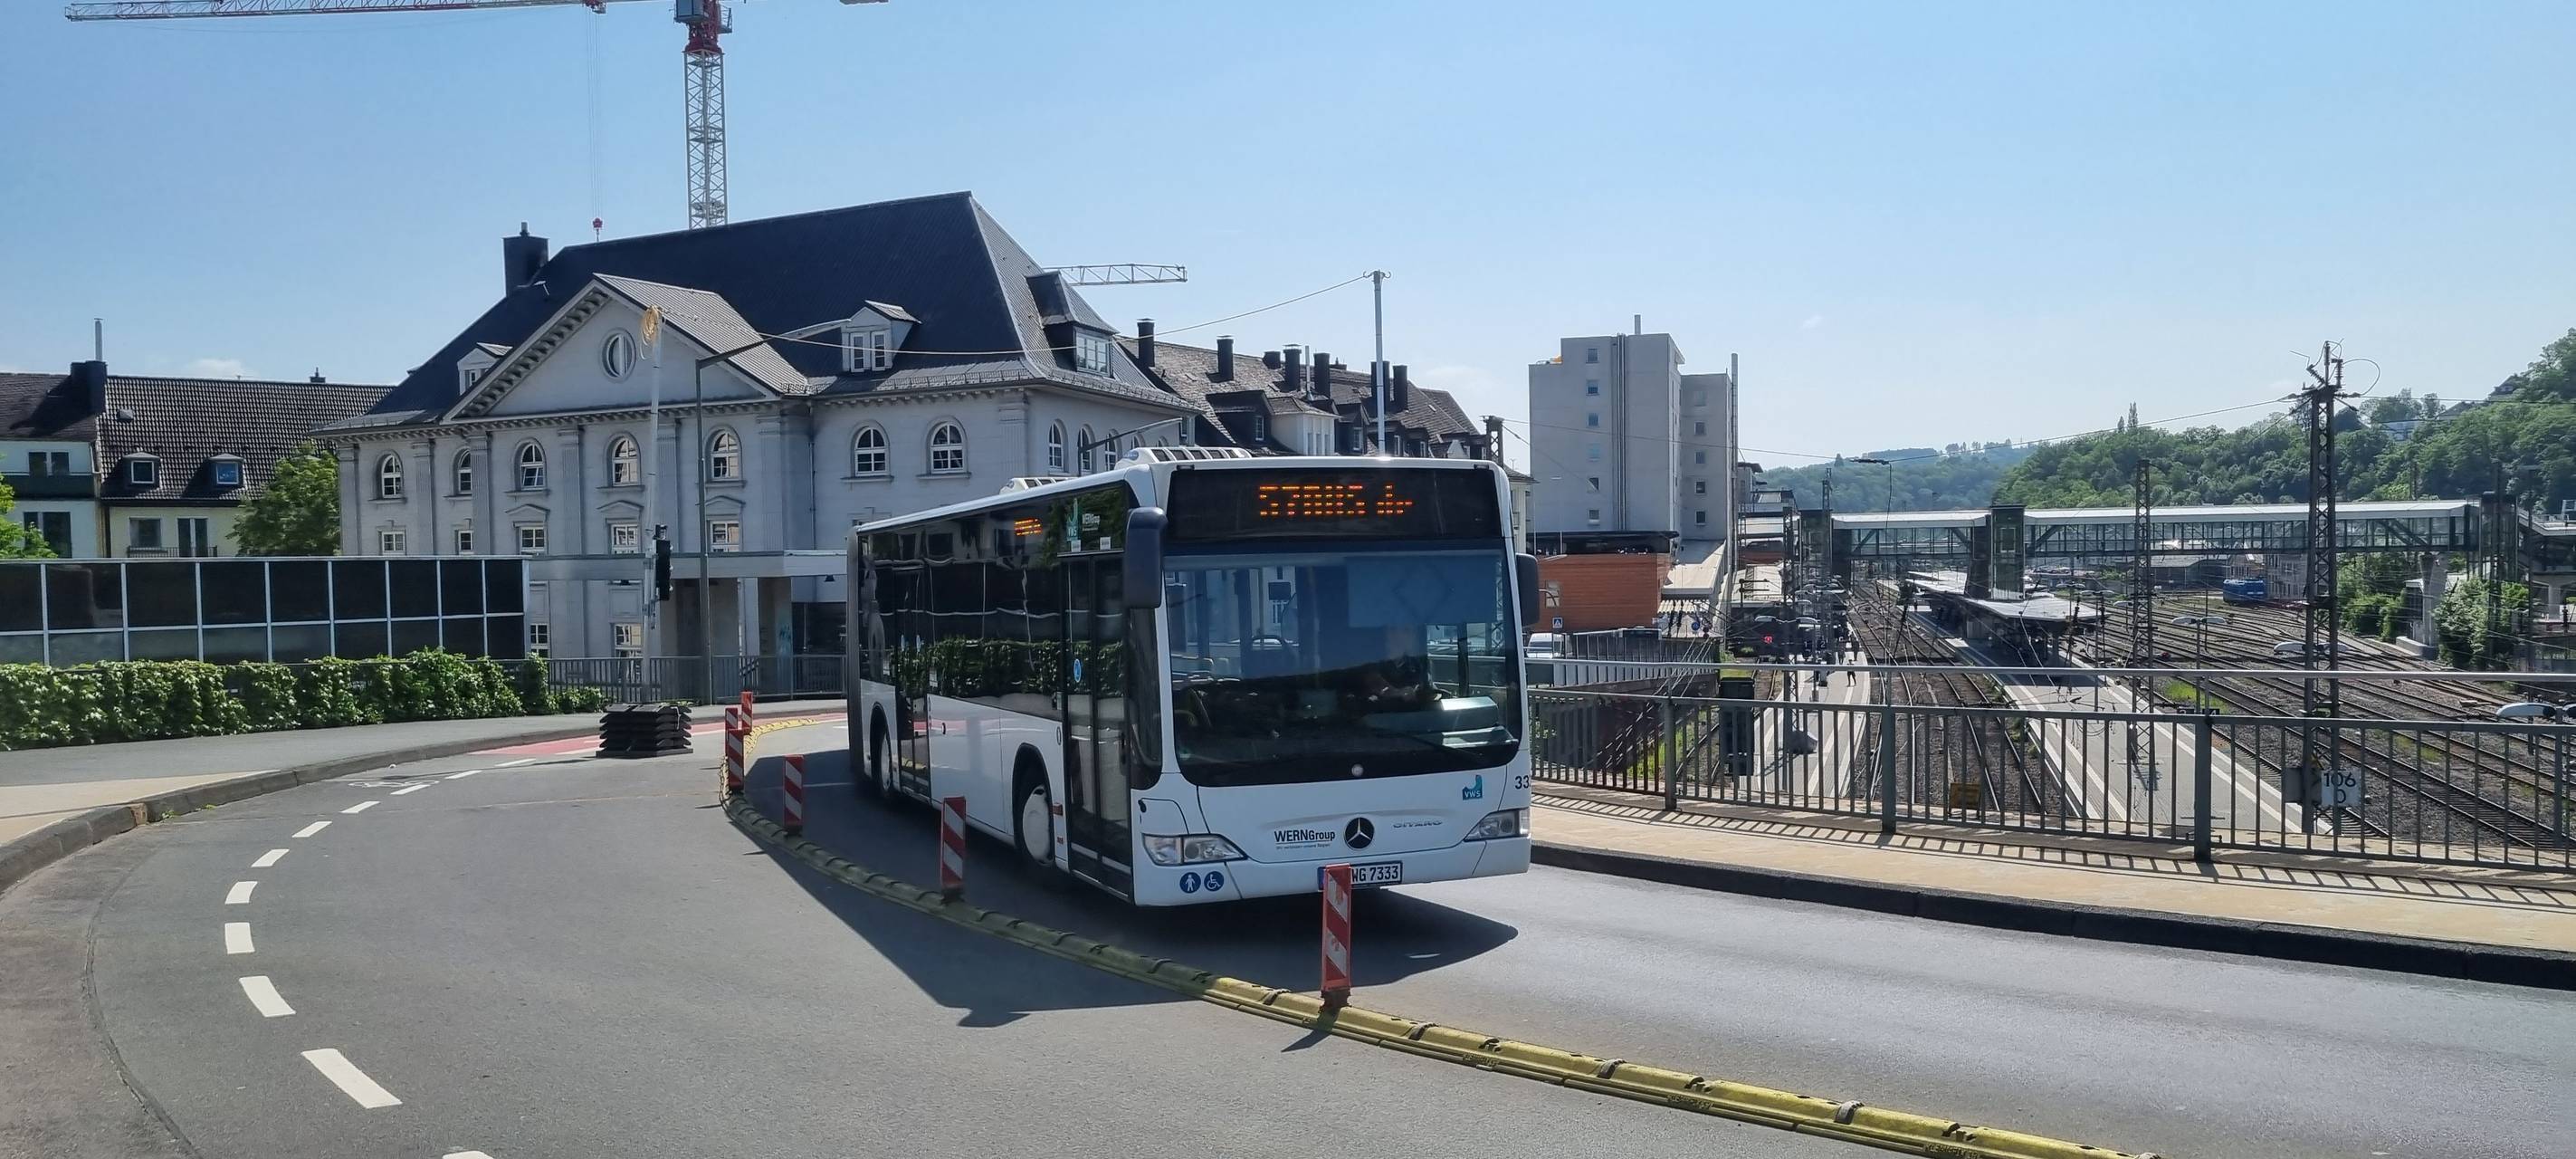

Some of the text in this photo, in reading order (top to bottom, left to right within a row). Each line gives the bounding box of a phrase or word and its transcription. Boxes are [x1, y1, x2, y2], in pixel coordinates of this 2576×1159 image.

[2323, 771, 2356, 788] 106
[1464, 790, 1482, 799] VWS
[1274, 829, 1336, 842] WERNGroup
[1369, 865, 1398, 881] 7333
